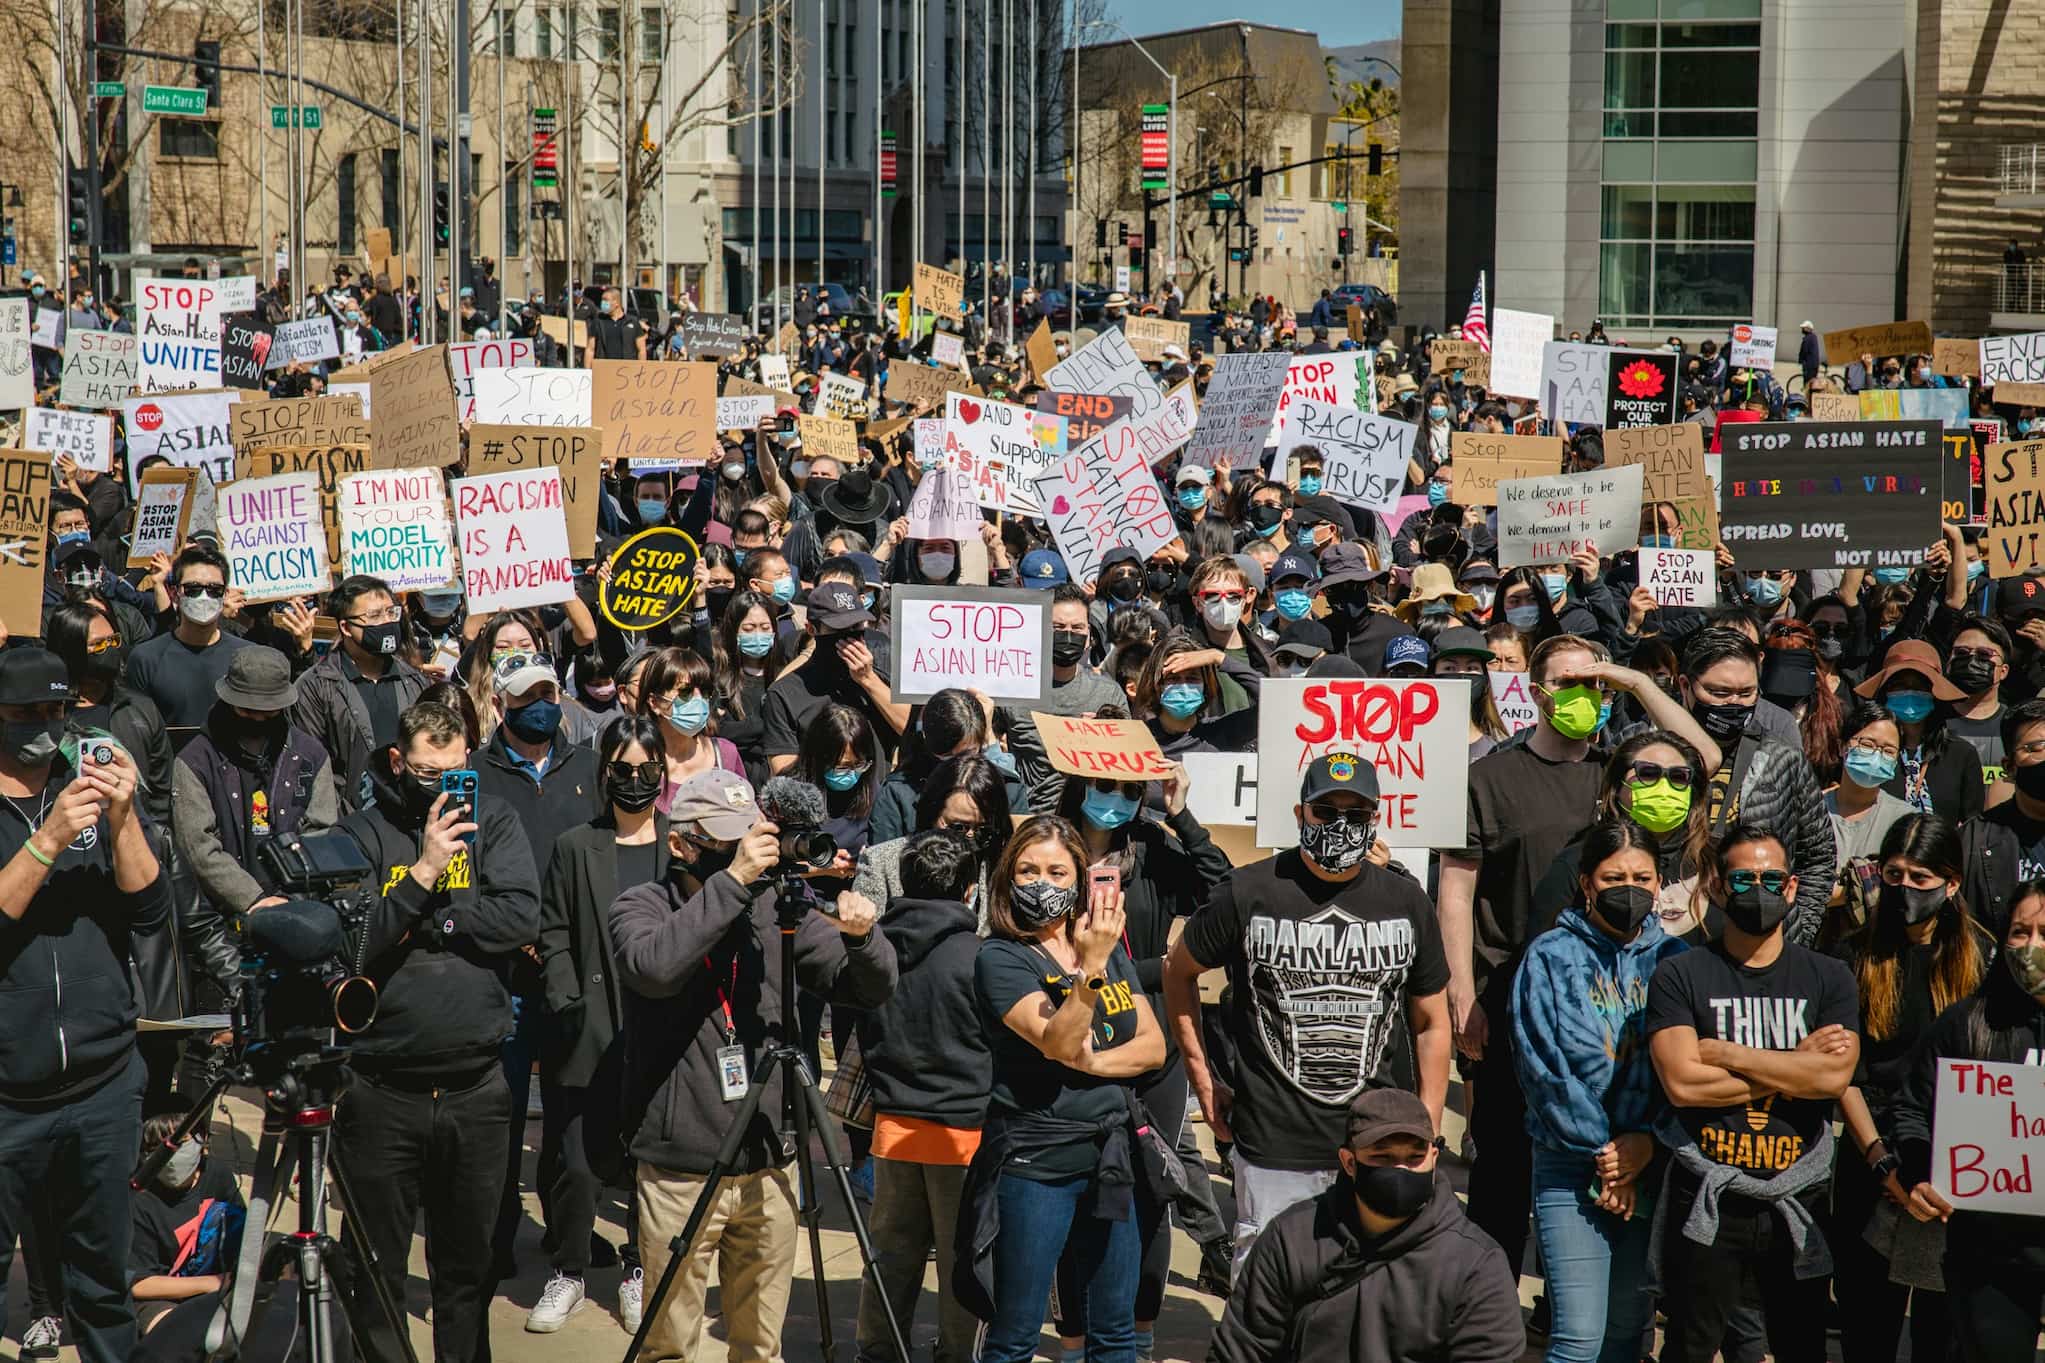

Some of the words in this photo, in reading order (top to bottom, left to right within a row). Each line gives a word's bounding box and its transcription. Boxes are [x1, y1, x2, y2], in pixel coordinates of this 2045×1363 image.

[146, 93, 170, 107] Santa
[172, 95, 193, 108] Clara
[195, 97, 205, 109] St
[305, 111, 318, 123] St
[931, 285, 945, 300] IS
[936, 272, 963, 293] HATE
[143, 285, 214, 312] STOP
[144, 313, 185, 336] Asian
[686, 315, 705, 334] Stop
[80, 334, 136, 354] STOP
[65, 355, 137, 380] ASIA
[142, 342, 220, 373] UNITE
[222, 354, 263, 380] ASIAN
[451, 342, 529, 377] TOP
[1283, 361, 1335, 386] TOP
[1983, 358, 2045, 384] RACIS
[498, 366, 592, 408] STOP
[331, 401, 361, 420] THE
[610, 398, 701, 421] asian
[722, 400, 759, 413] STOP
[983, 405, 1012, 427] AND
[1057, 394, 1115, 418] END
[1614, 400, 1667, 412] PROTECT
[1627, 411, 1653, 423] OUR
[38, 412, 95, 434] THIS
[136, 412, 162, 424] STOP
[804, 419, 851, 437] #STOP
[920, 420, 945, 431] #ST
[37, 431, 95, 450] ENDS
[616, 425, 697, 456] hate
[922, 434, 945, 445] ASI
[1068, 420, 1104, 440] sia
[1296, 403, 1404, 459] RACISM
[1619, 426, 1686, 449] STOP
[1738, 433, 1791, 450] STOP
[1804, 431, 1864, 449] ASIAN
[1875, 430, 1926, 447] HATE
[483, 435, 586, 467] #STOP
[1361, 452, 1372, 467] A
[1463, 436, 1506, 464] Stop
[1994, 443, 2042, 483] ST
[4, 458, 50, 494] OP
[1325, 461, 1401, 504] IRUS!
[1643, 472, 1691, 499] ATE
[352, 479, 393, 505] I'M
[395, 476, 433, 501] NOT
[460, 478, 562, 520] RACISM
[1531, 484, 1573, 497] deserve
[1582, 482, 1594, 495] to
[1600, 480, 1615, 493] be
[1733, 479, 1781, 497] HATE
[143, 504, 178, 515] #STOP
[228, 484, 309, 526] UNITE
[352, 506, 435, 527] YOUR
[1545, 499, 1592, 518] SAFE
[1992, 489, 2045, 529] ASIA
[141, 516, 175, 527] ASIAN
[1528, 521, 1570, 537] demand
[1579, 520, 1590, 533] to
[1600, 518, 1612, 530] be
[1721, 524, 1793, 541] SPREAD
[1801, 523, 1849, 543] LOVE,
[138, 527, 172, 540] HATE
[231, 522, 310, 550] AGAINST
[352, 525, 440, 549] MODEL
[466, 528, 489, 556] IS
[506, 524, 527, 553] A
[234, 547, 318, 586] RACISM
[352, 545, 446, 577] MINORITY
[631, 548, 686, 571] STOP
[1657, 552, 1695, 568] STOP
[1835, 550, 1872, 566] NOT
[467, 556, 574, 598] PANDEMIC
[615, 570, 689, 596] ASIAN
[1650, 569, 1703, 585] ASIAN
[613, 594, 666, 617] HATE
[1655, 587, 1695, 607] HATE
[928, 604, 1025, 643] STOP
[912, 647, 976, 675] ASIAN
[985, 648, 1034, 678] HATE
[1295, 681, 1439, 744] STOP
[1501, 708, 1534, 719] AND
[1063, 720, 1128, 737] HATE
[1056, 747, 1171, 775] VIRUS
[1297, 741, 1425, 781] AAN
[1378, 794, 1419, 829] TE
[1249, 915, 1413, 974] OAKLAND
[1709, 996, 1809, 1050] THINK
[1951, 1064, 2015, 1098] The
[1700, 1125, 1804, 1171] CHANGE
[1949, 1143, 2033, 1198] Bad
